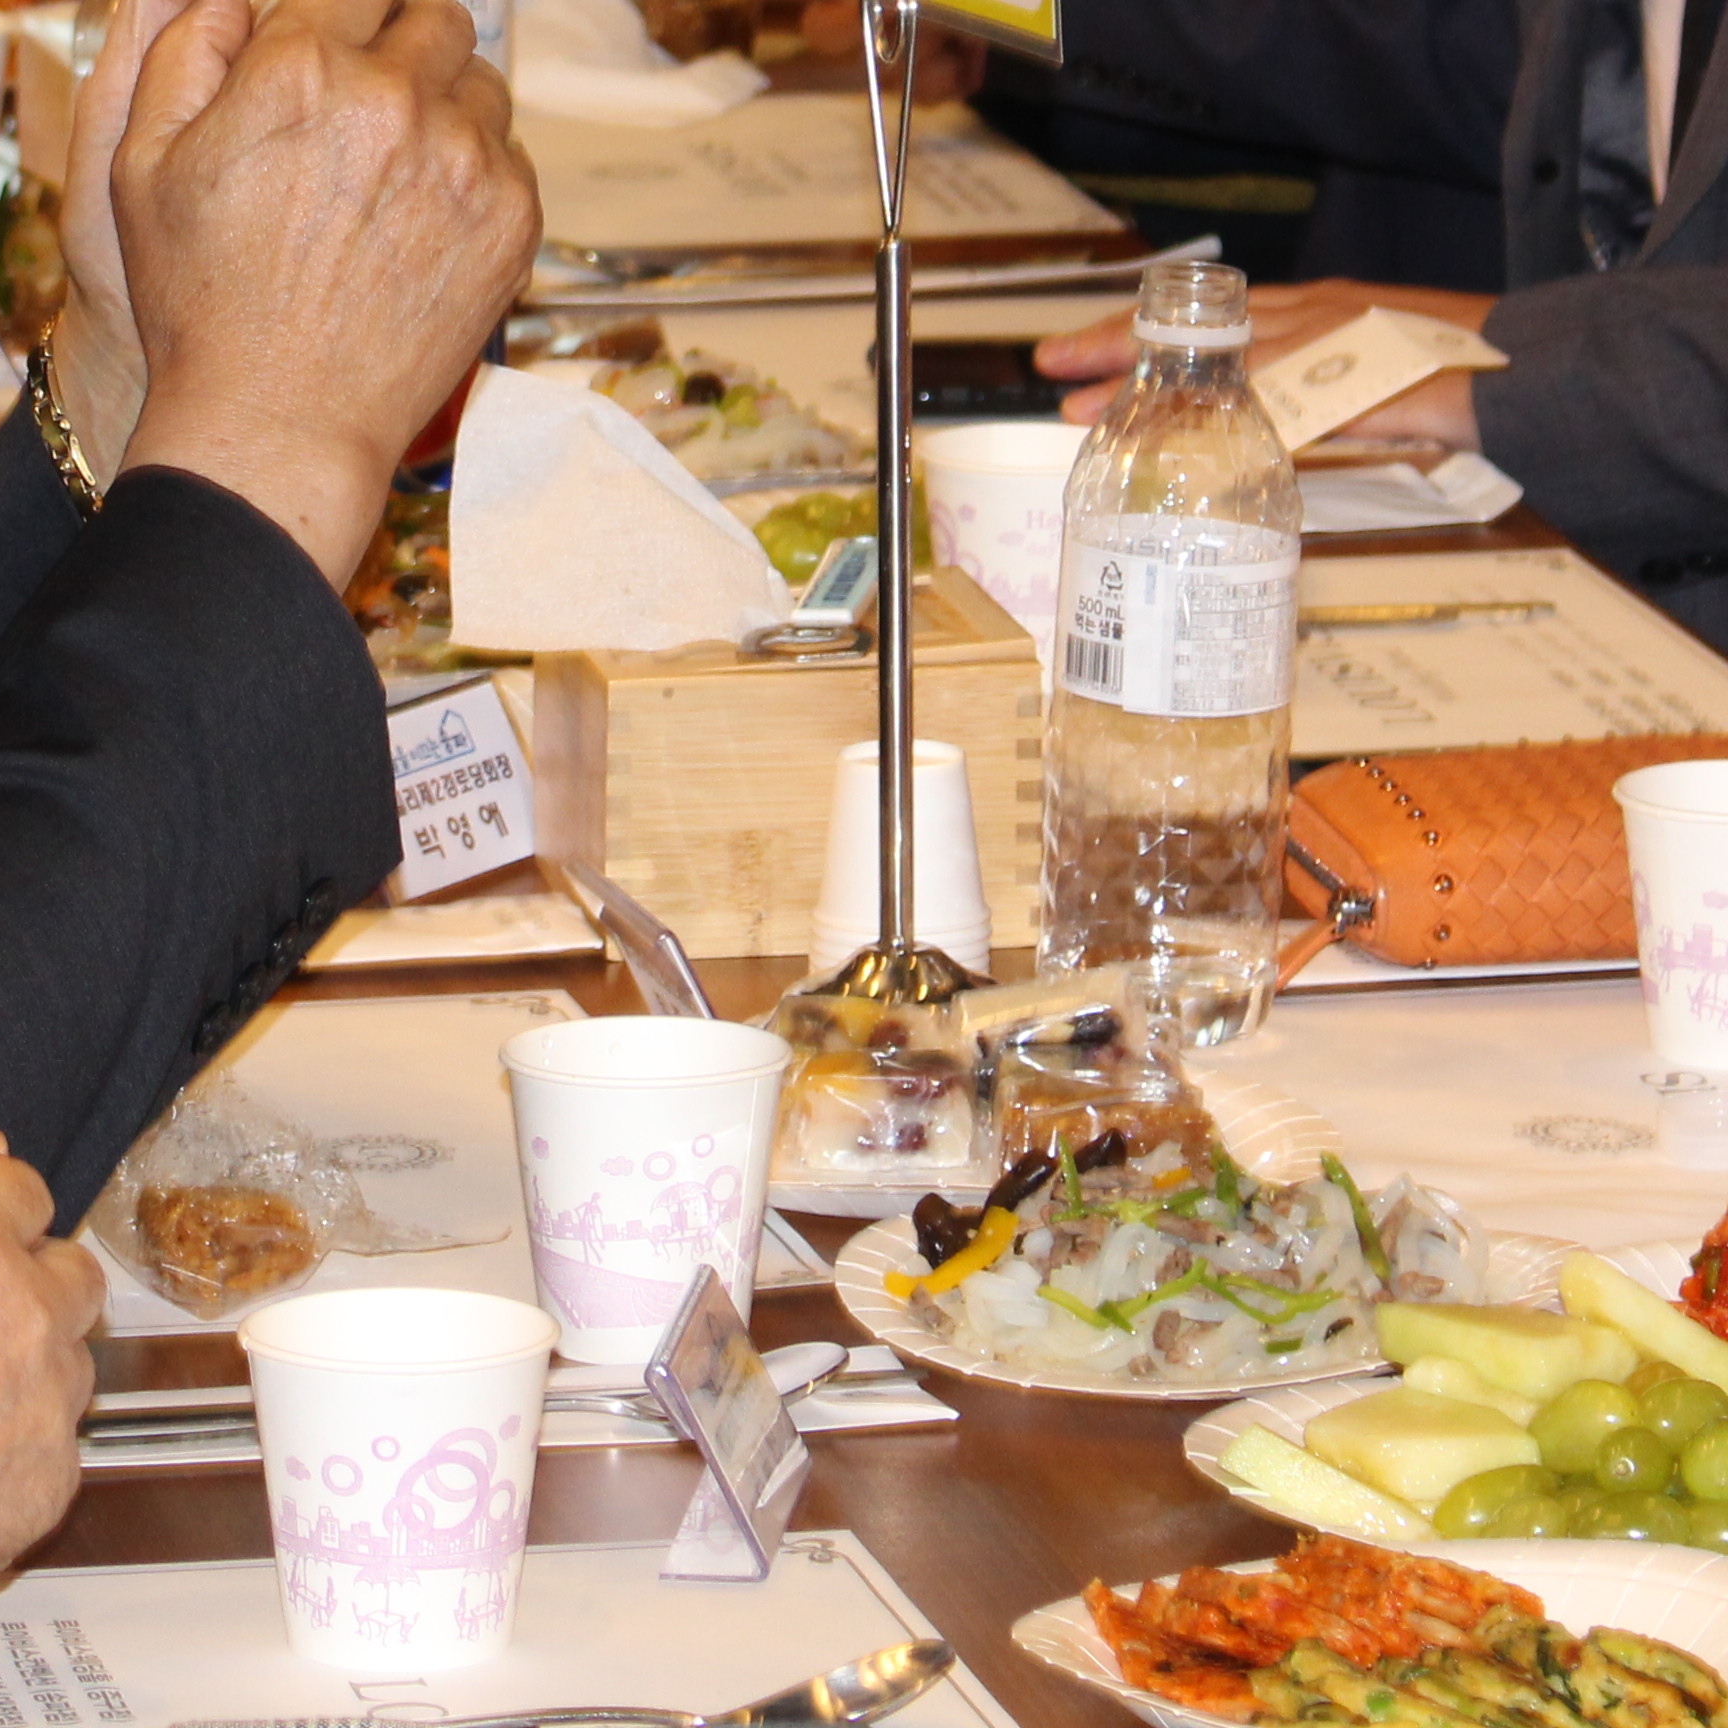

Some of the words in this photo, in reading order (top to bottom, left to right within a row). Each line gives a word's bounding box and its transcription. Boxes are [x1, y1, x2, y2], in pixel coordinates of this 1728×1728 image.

[1078, 597, 1103, 615] 500
[1075, 612, 1096, 634] 먹는
[414, 802, 509, 859] 박영애
